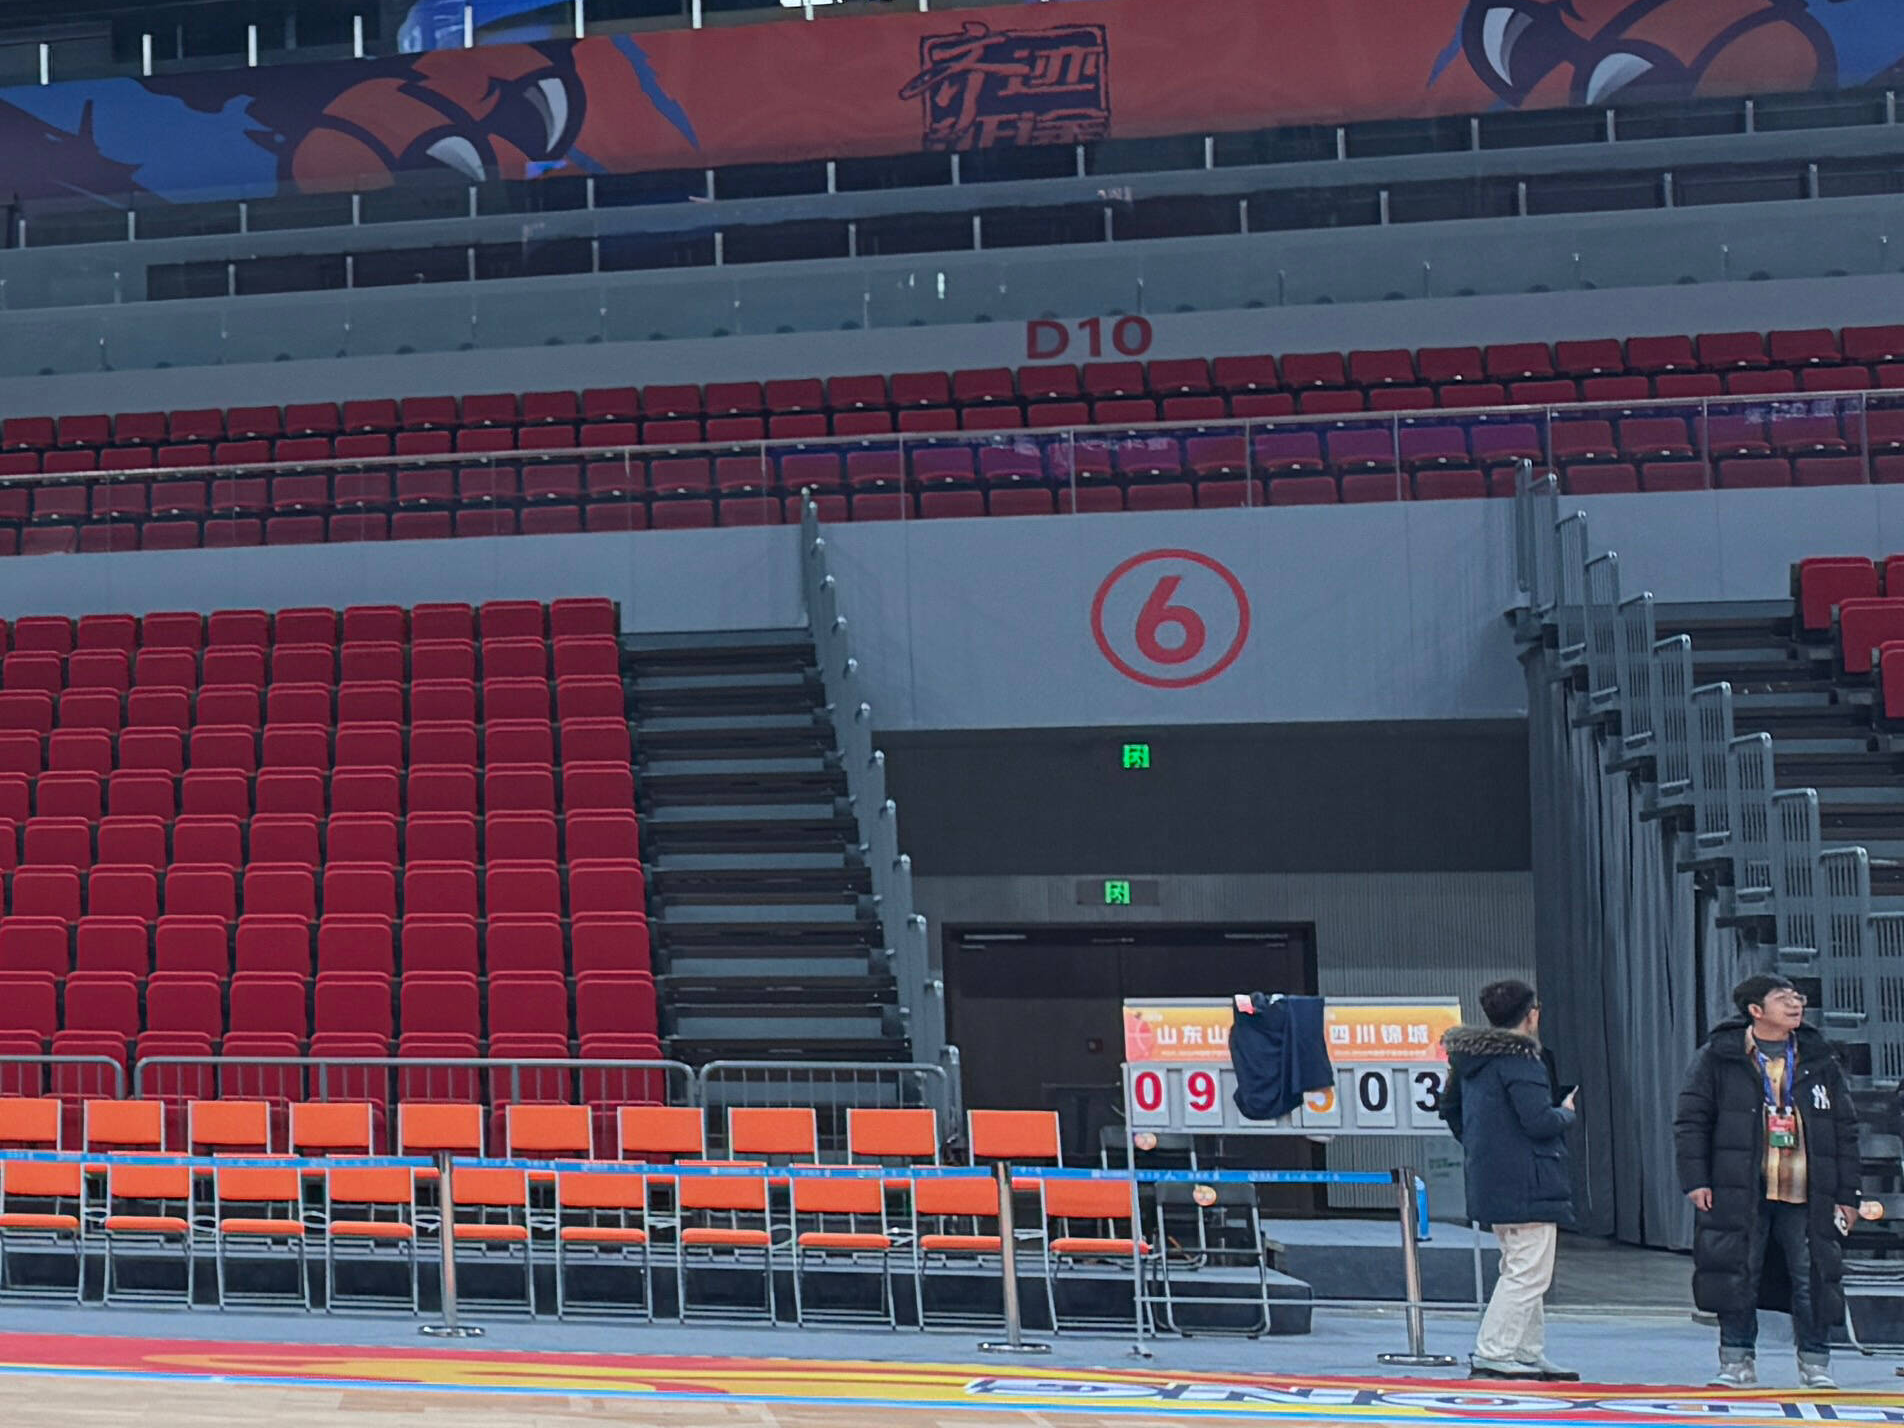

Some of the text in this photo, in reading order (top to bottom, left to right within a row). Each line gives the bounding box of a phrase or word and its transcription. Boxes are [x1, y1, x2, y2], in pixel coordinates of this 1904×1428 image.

[1026, 315, 1154, 359] D10
[1133, 575, 1205, 664] 6
[1135, 1071, 1216, 1112] 0 9
[1360, 1071, 1388, 1112] 0
[1415, 1071, 1441, 1112] 3
